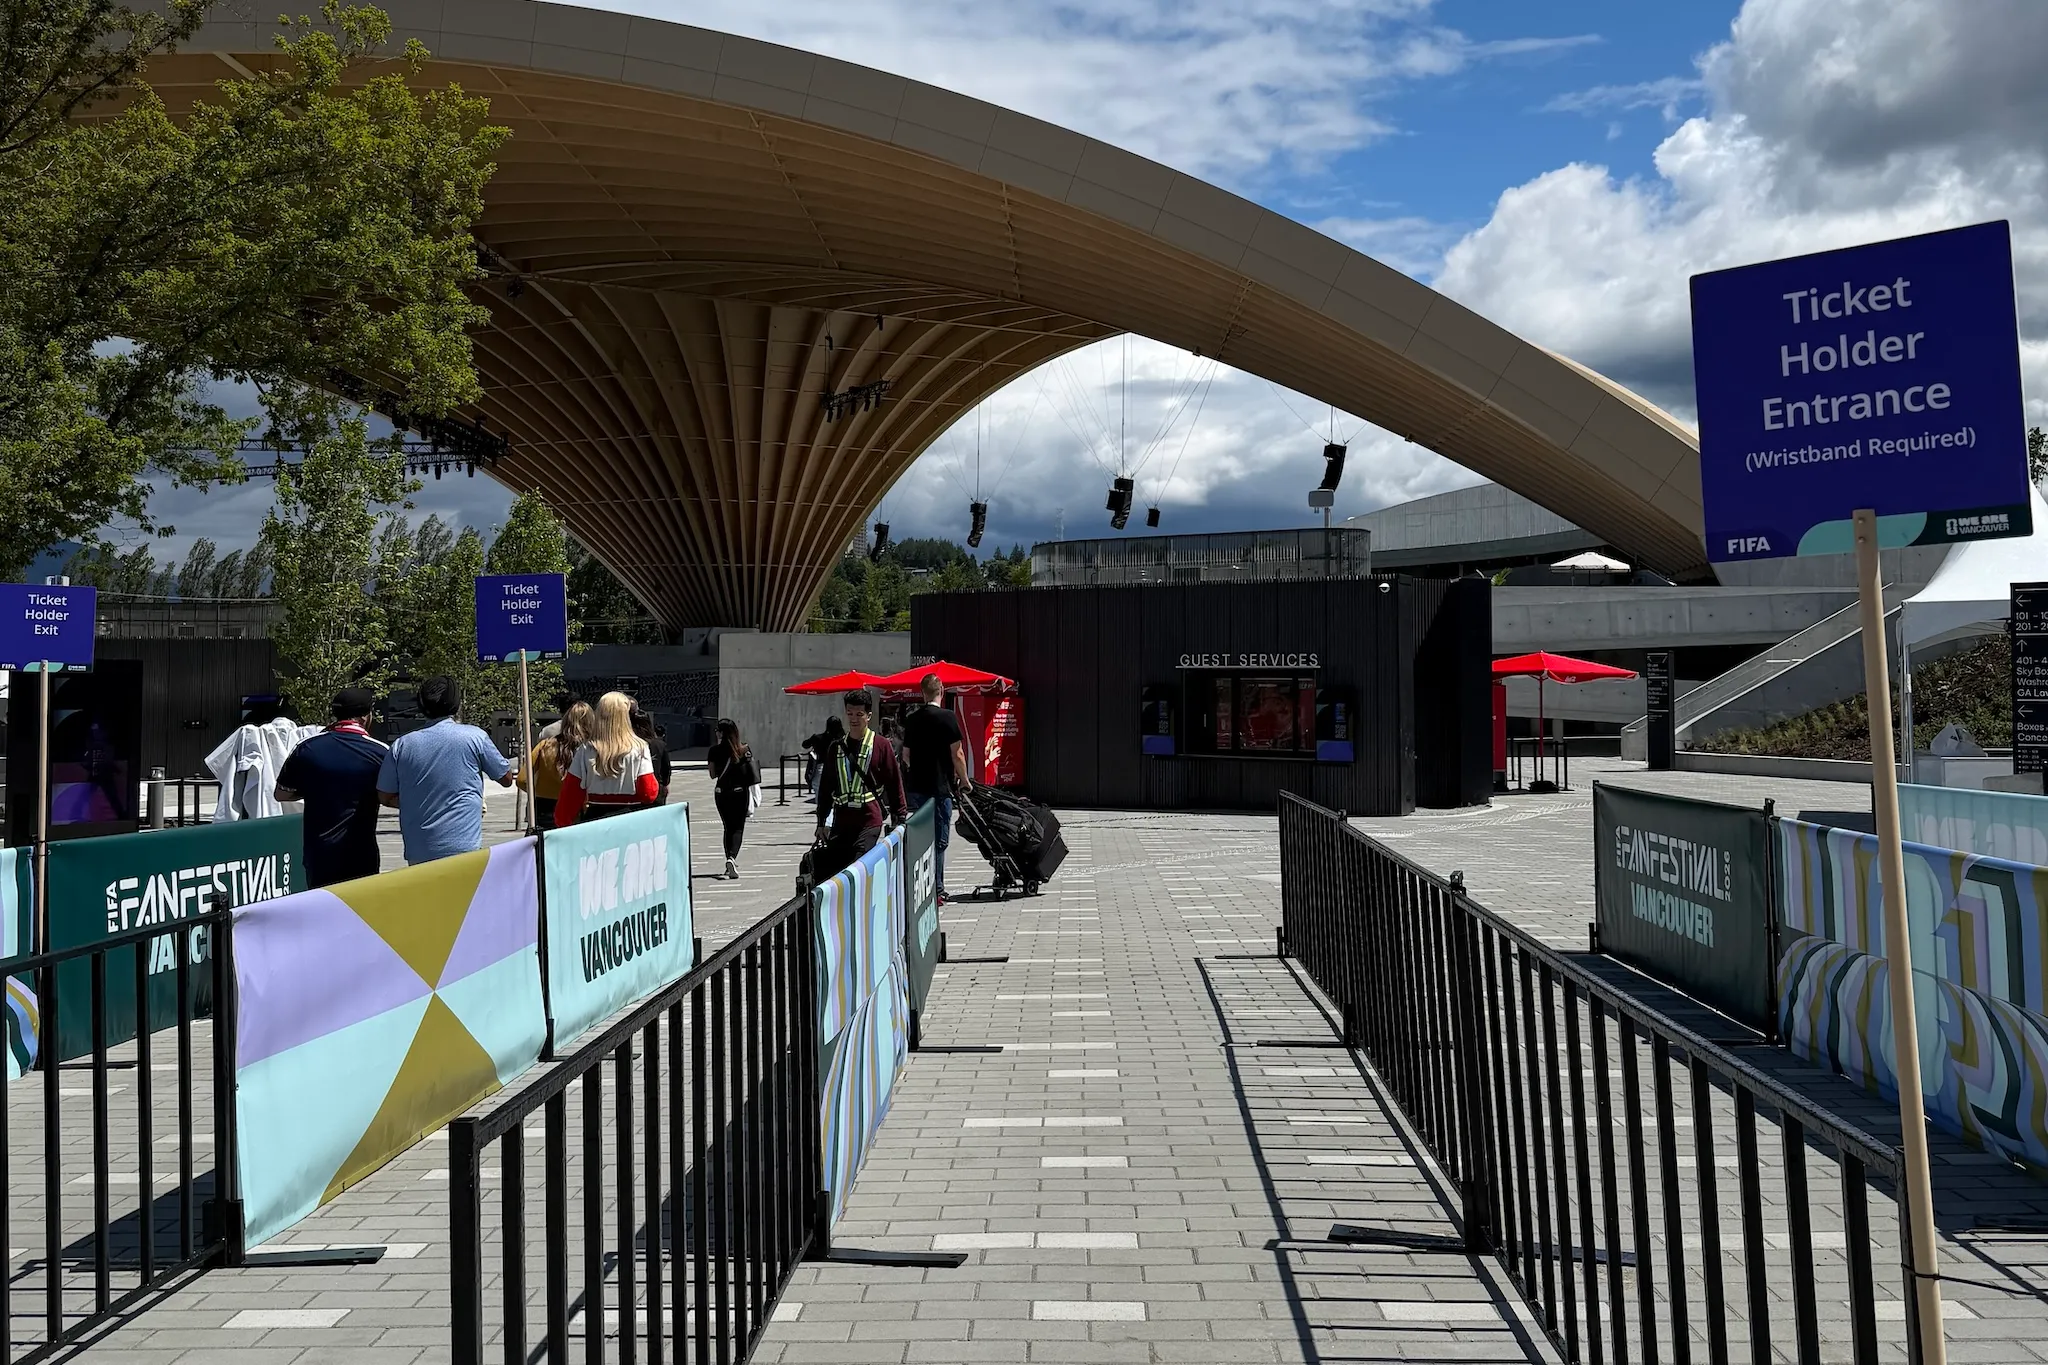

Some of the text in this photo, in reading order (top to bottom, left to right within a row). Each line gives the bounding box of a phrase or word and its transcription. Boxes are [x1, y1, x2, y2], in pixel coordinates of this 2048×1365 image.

[1782, 276, 1912, 324] Ticket
[1780, 329, 1925, 377] Holder
[1763, 382, 1951, 431] Entrance
[1745, 426, 1977, 473] (Wristband Required)
[1959, 523, 2010, 535] VANCOUVER
[1727, 536, 1771, 554] FIFA
[502, 583, 540, 595] Ticket
[27, 593, 68, 606] Ticket
[501, 598, 543, 611] Holder
[24, 608, 70, 621] Holder
[510, 613, 534, 625] Exit
[2015, 611, 2029, 620] 101
[34, 623, 59, 636] Exit
[2015, 622, 2031, 631] 201
[1179, 653, 1319, 666] GUEST SERVICES
[2016, 656, 2033, 665] 401
[2016, 666, 2048, 677] Sky Bo
[2017, 688, 2032, 697] GA
[2017, 722, 2045, 731] Boxes
[1723, 851, 1732, 902] 2026
[106, 880, 120, 933] FIFA
[1630, 881, 1714, 948] VANCOUVER
[580, 902, 668, 984] VANCOUVER
